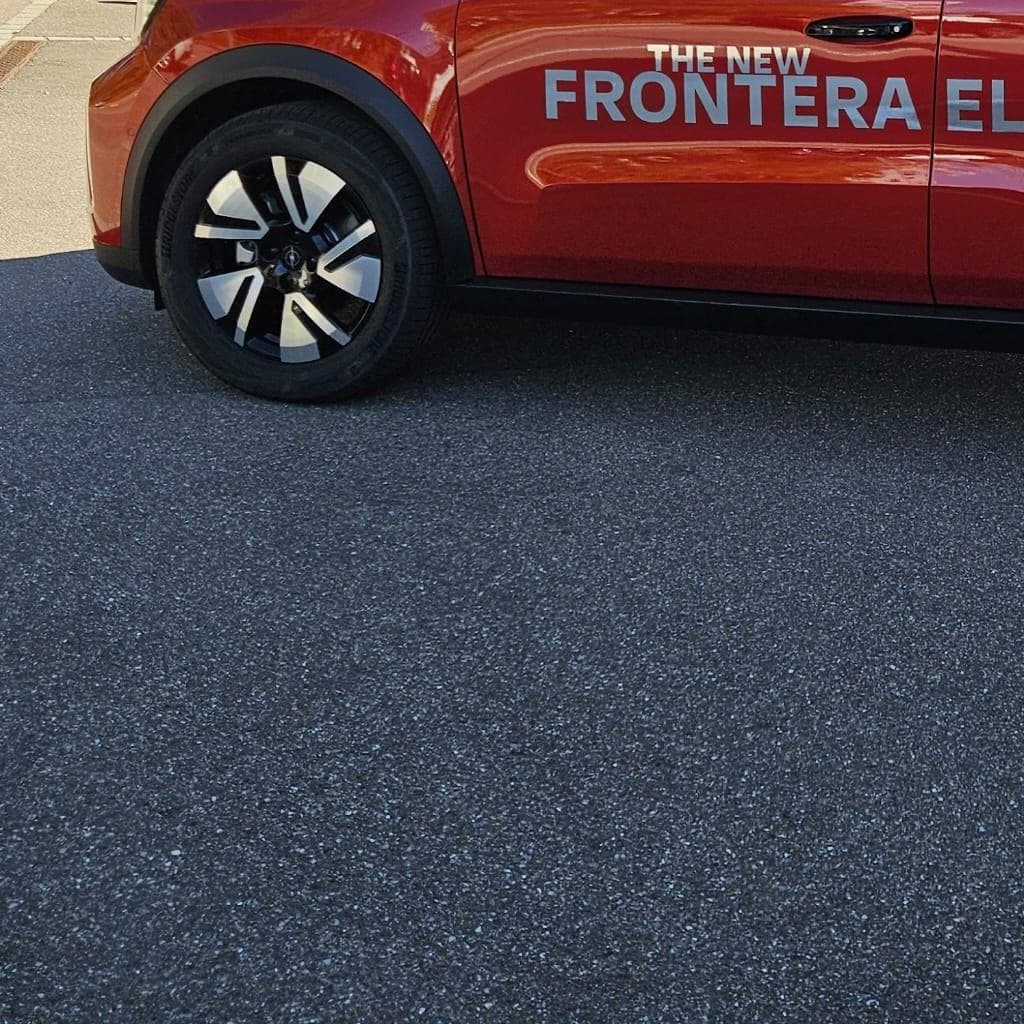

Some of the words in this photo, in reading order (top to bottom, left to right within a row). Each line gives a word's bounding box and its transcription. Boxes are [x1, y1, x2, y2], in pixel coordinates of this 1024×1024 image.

[646, 44, 716, 72] THE
[726, 45, 811, 74] NEW
[544, 69, 922, 130] FRONTERA
